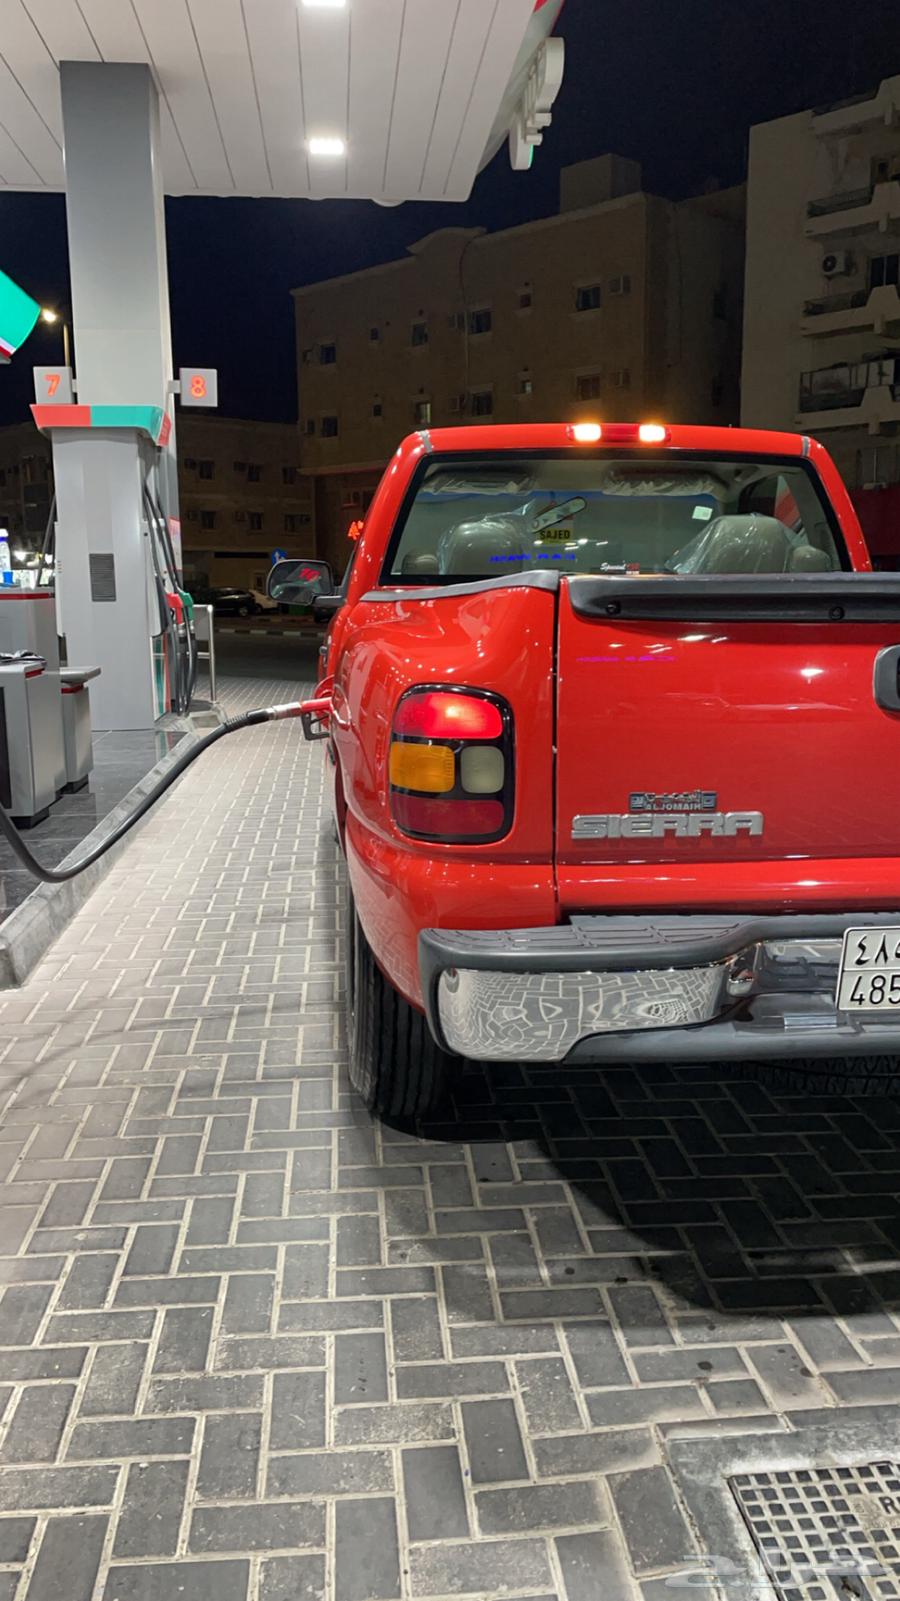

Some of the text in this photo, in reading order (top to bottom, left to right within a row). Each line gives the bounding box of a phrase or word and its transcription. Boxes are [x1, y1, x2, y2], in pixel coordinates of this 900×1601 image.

[44, 374, 61, 397] 7
[190, 375, 207, 398] 8
[539, 529, 571, 540] SAJED
[571, 811, 764, 839] SIERRA
[878, 1495, 900, 1516] R
